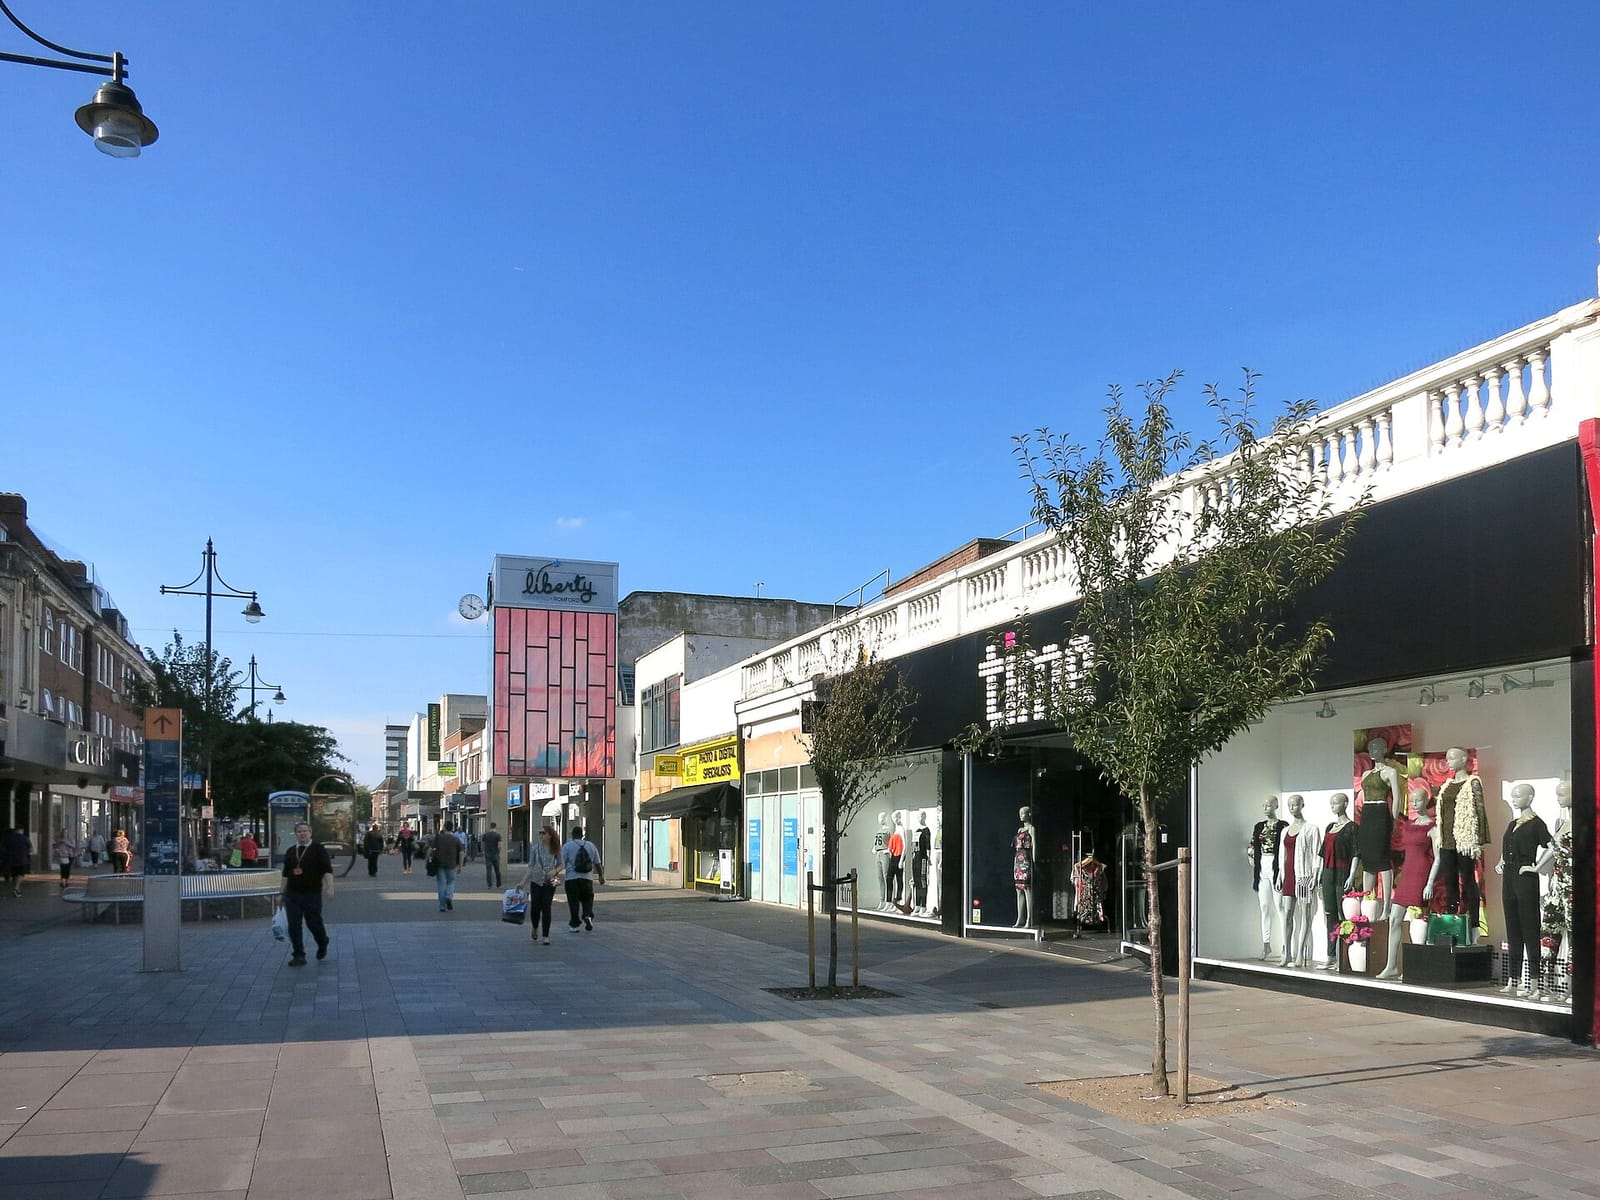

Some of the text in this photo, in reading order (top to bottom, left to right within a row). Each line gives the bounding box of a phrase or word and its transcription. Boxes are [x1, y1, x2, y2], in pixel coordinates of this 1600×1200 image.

[522, 565, 598, 603] liberty
[699, 751, 713, 764] PHOTO
[718, 746, 736, 761] DIGITAL
[703, 764, 732, 779] SPECIALISTS
